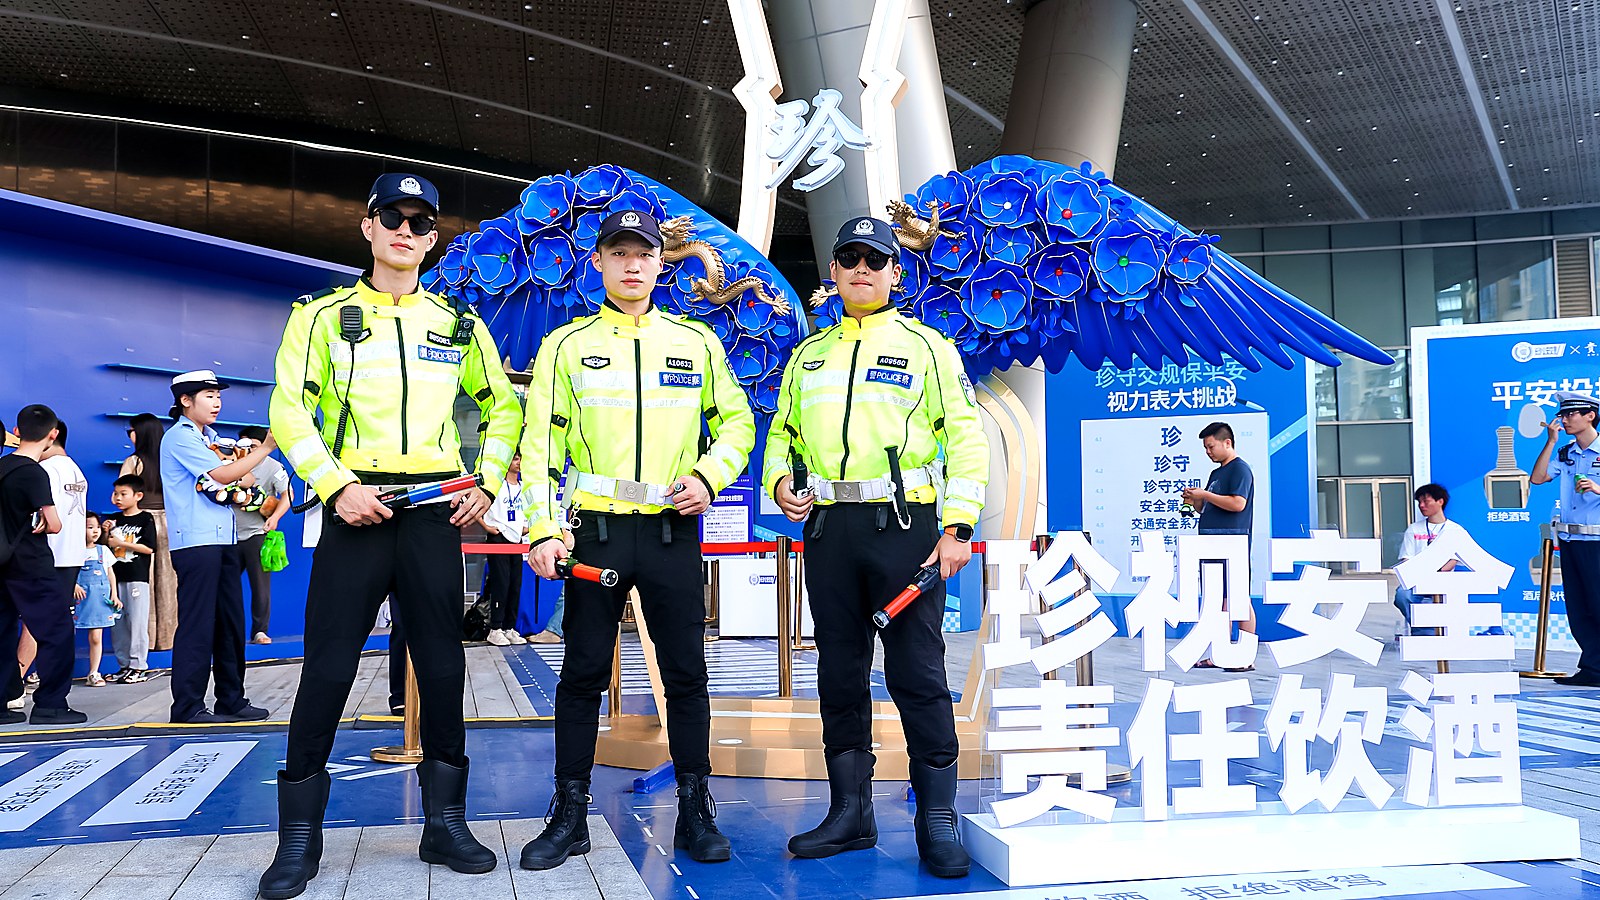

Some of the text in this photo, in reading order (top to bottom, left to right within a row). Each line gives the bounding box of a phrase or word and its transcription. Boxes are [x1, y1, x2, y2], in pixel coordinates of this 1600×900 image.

[764, 88, 873, 192] 珍
[1107, 386, 1236, 412] 视力表大挑战
[1161, 425, 1182, 447] 珍
[1153, 455, 1190, 473] 珍守
[1487, 511, 1530, 522] 拒绝酒驾
[984, 529, 1516, 675] 珍视安全
[984, 671, 1523, 828] 责任饮酒
[1180, 873, 1388, 900] 拒绝酒驾
